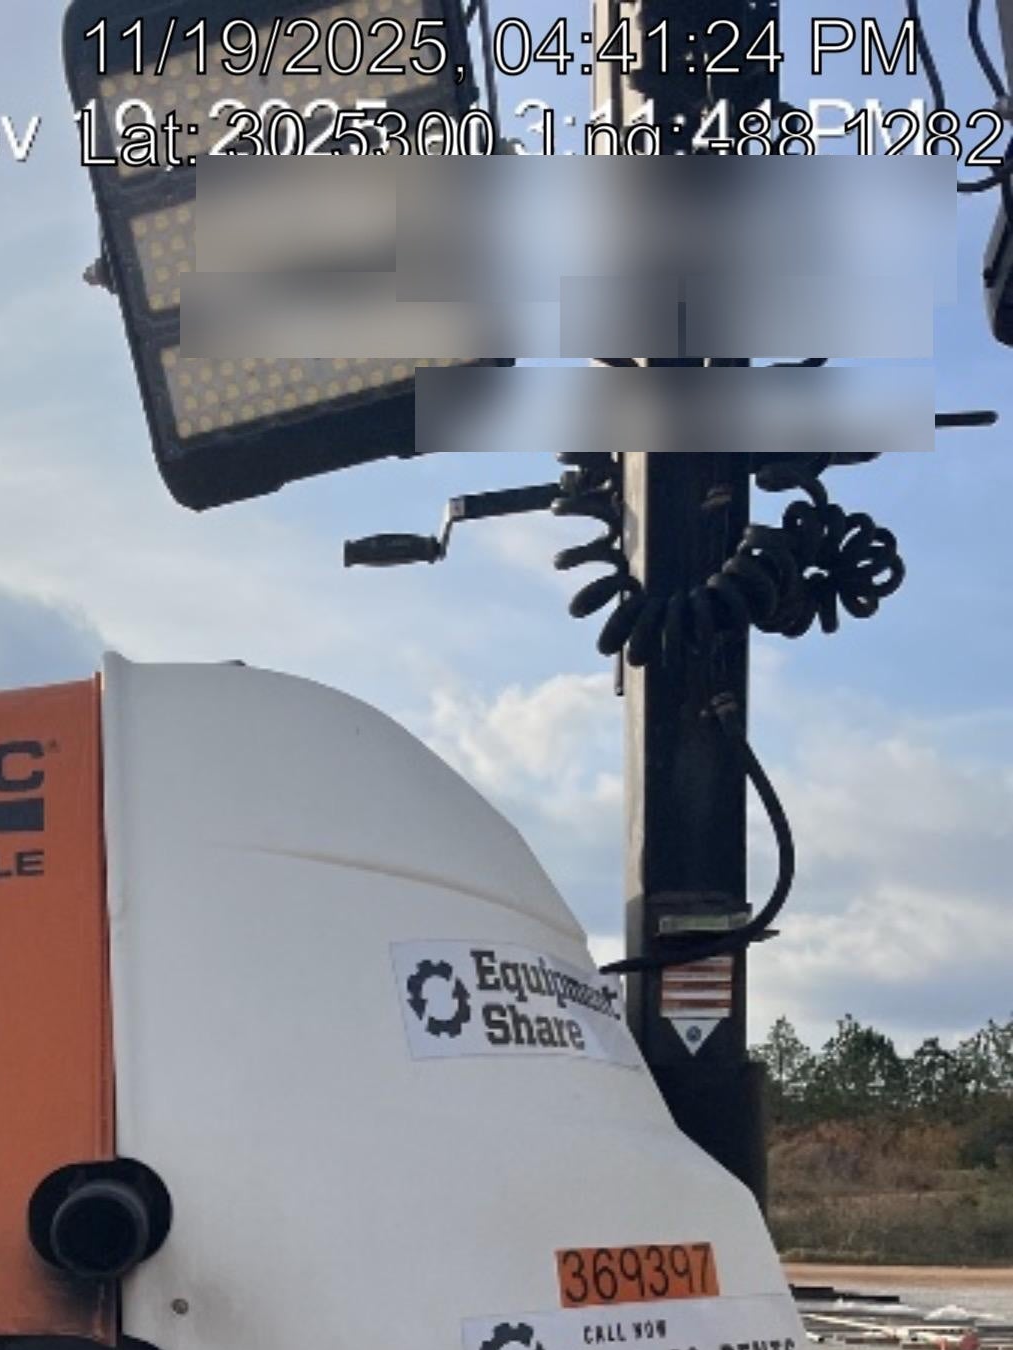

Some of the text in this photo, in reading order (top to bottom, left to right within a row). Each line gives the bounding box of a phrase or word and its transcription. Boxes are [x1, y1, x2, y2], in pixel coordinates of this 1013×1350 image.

[470, 949, 619, 1018] Equipment
[482, 1003, 585, 1050] Share
[561, 1243, 712, 1303] 369397
[583, 1319, 666, 1344] CALL NOW
